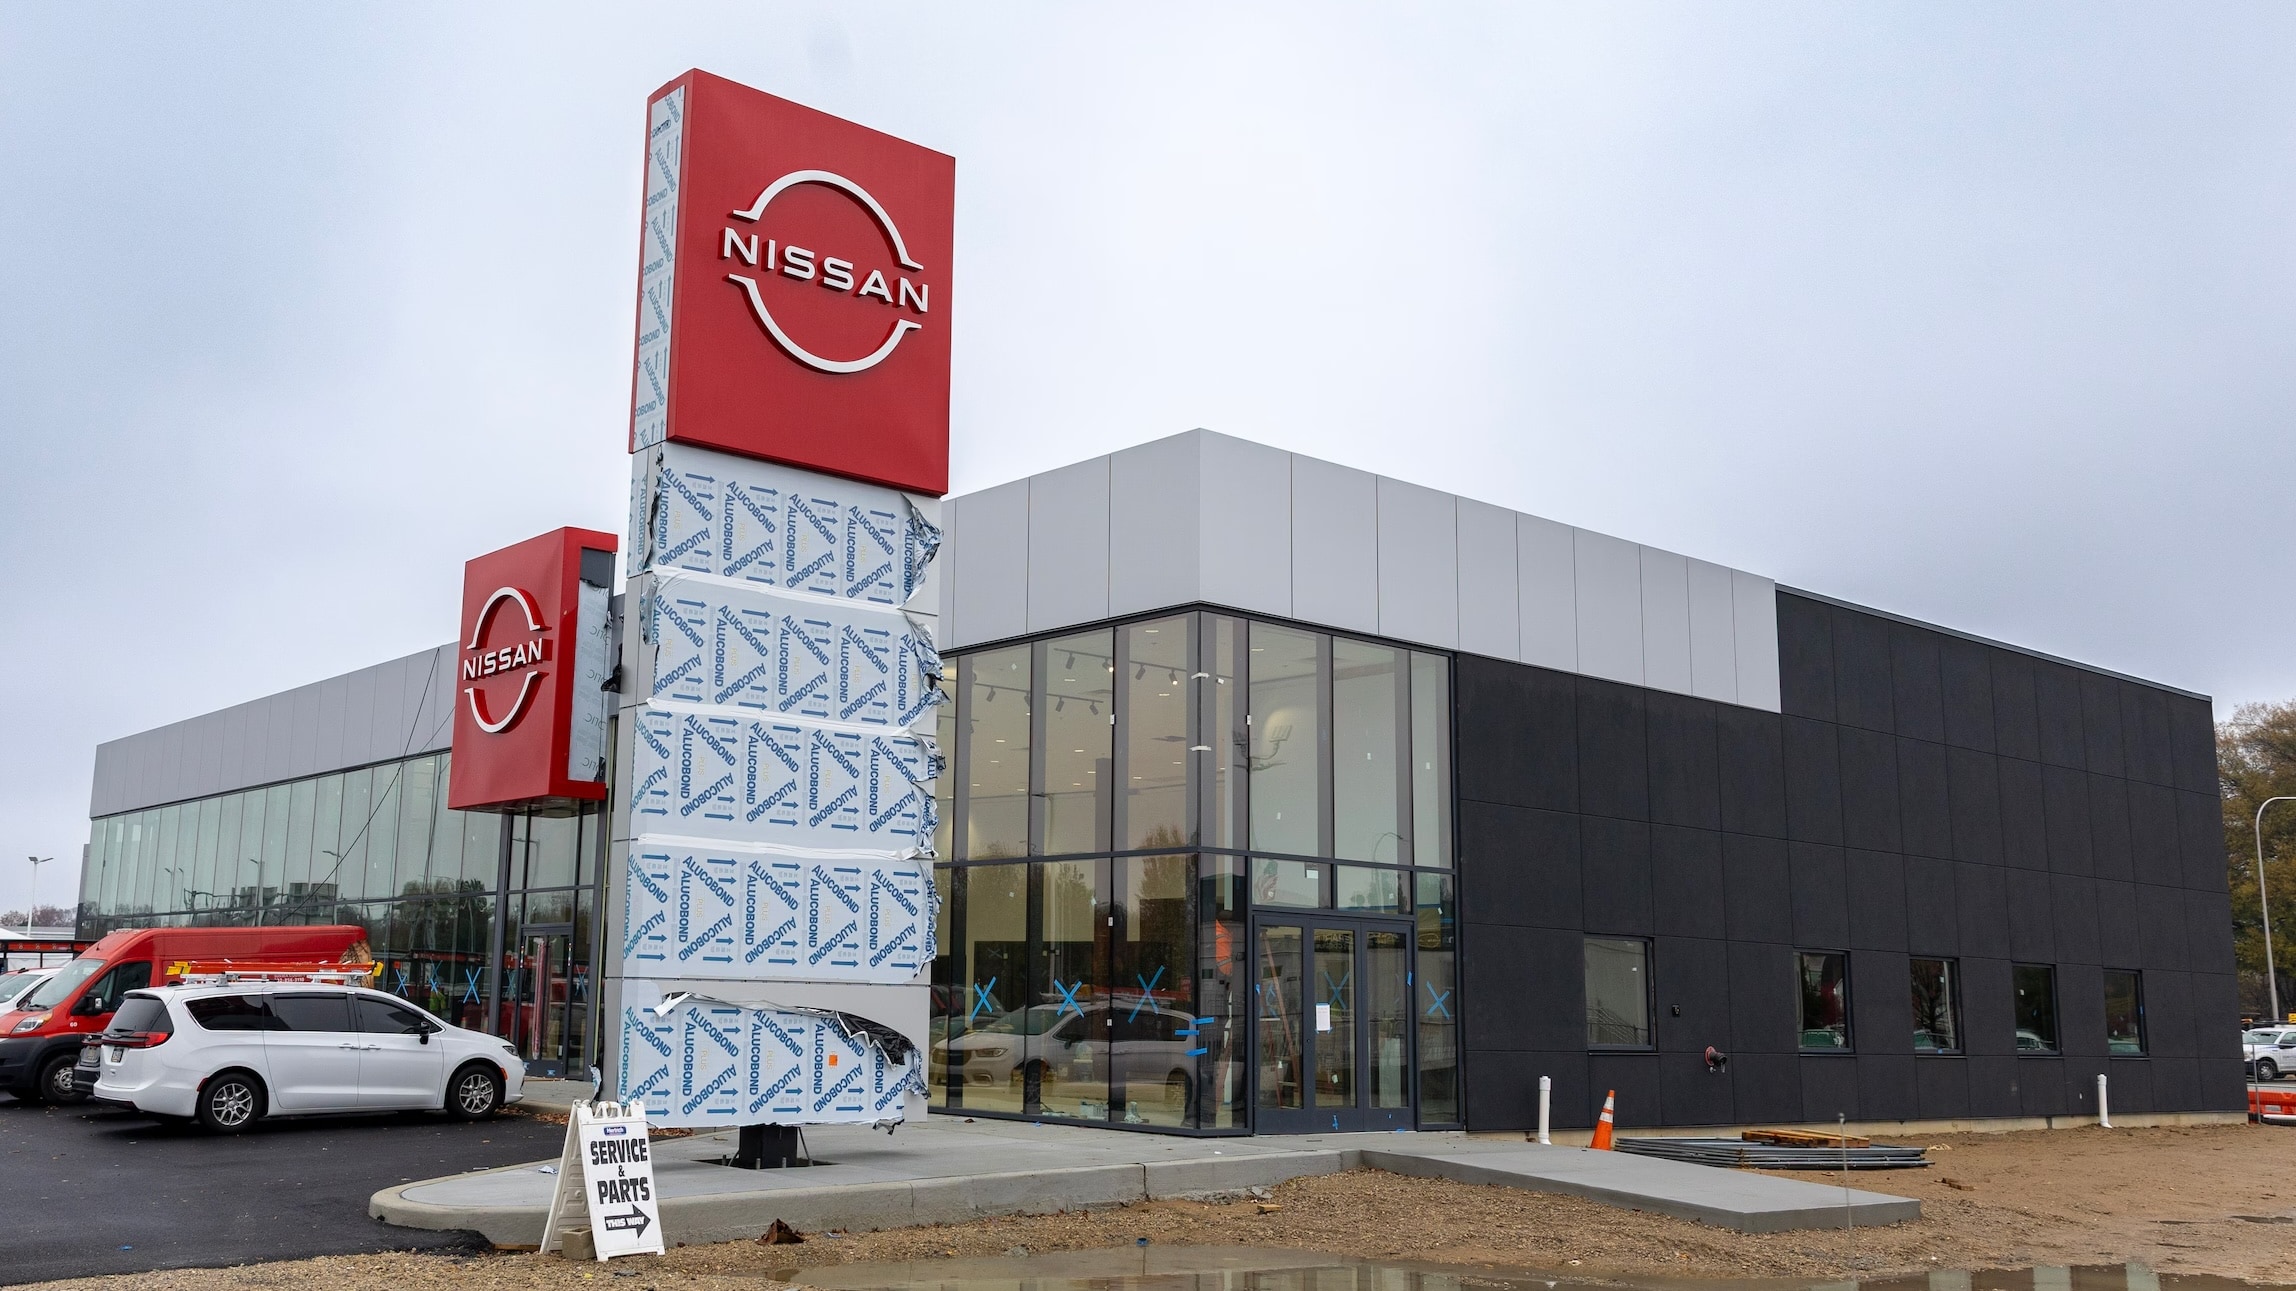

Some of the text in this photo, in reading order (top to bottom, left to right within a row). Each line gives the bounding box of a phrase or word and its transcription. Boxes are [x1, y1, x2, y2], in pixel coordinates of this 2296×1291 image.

[723, 227, 929, 313] NISSAN
[658, 481, 671, 549] ALUCOBOND
[662, 468, 713, 522] ALUCOBOND
[726, 481, 776, 533] ALUCOBOND
[789, 493, 837, 545] ALUCOBOND
[658, 527, 711, 566] ALUCOBOND
[723, 493, 735, 561] ALUCOBOND
[786, 506, 798, 572] ALUCOBOND
[846, 517, 857, 582] ALUCOBOND
[849, 505, 894, 556] ALUCOBOND
[723, 539, 774, 577] ALUCOBOND
[786, 550, 835, 588] ALUCOBOND
[846, 561, 893, 599] ALUCOBOND
[655, 595, 704, 648] ALUCOBOND
[718, 605, 768, 657] ALUCOBOND
[781, 614, 830, 666] ALUCOBOND
[463, 638, 543, 681] NISSAN
[715, 618, 728, 687] ALUCOBOND
[778, 627, 790, 696] ALUCOBOND
[839, 636, 851, 703] ALUCOBOND
[842, 624, 889, 674] ALUCOBOND
[653, 654, 702, 696] ALUCOBON
[714, 662, 766, 704] ALUCOBOND
[779, 671, 828, 713] ALUCOBOND
[839, 680, 887, 720] ALUCOBOND
[898, 646, 908, 711] ALUCOBOND
[680, 727, 694, 799] ALUCOBOND
[685, 714, 736, 767] ALUCOBOND
[750, 722, 799, 773] ALUCOBOND
[812, 729, 860, 779] ALUCOBOND
[680, 772, 734, 817] ALUCOBOND
[746, 735, 759, 805] ALUCOBOND
[809, 742, 821, 810] ALUCOBOND
[869, 749, 880, 816] ALUCOBOND
[746, 779, 797, 822] ALUCOBOND
[809, 785, 858, 828] ALUCOBOND
[869, 790, 916, 832] ALUCOBOND
[628, 854, 668, 904] ALUCOBOND
[683, 856, 735, 907] ALUCOBOND
[748, 860, 798, 911] ALUCOBOND
[812, 864, 860, 914] ALUCOBOND
[872, 869, 918, 917] ALUCOBOND
[679, 870, 692, 943] ALUCOBOND
[745, 874, 758, 946] ALUCOBOND
[808, 879, 821, 948] ALUCOBOND
[869, 882, 881, 950] ALUCOBOND
[623, 910, 666, 960] ALUCOBOND
[679, 913, 733, 961] ALUCOBOND
[745, 916, 797, 963] ALUCOBOND
[808, 920, 858, 965] ALUCOBOND
[869, 922, 917, 967] ALUCOBOND
[625, 1006, 672, 1058] ALUCOBOND
[687, 1007, 739, 1058] ALUCOBOND
[753, 1010, 804, 1058] ALUCOBOND
[620, 1021, 632, 1096] ALUCOBOND
[682, 1022, 697, 1096] ALUCOBOND
[749, 1023, 762, 1095] ALUCOBOND
[813, 1023, 825, 1095] ALUCOBOND
[682, 1064, 737, 1115] ALUCOBOND
[749, 1064, 801, 1114] ALUCOBOND
[813, 1064, 863, 1113] ALUCOBOND
[590, 1138, 648, 1166] SERVICE
[618, 1165, 625, 1177] &
[597, 1177, 650, 1204] PARTS
[606, 1216, 645, 1228] THIS WAY
